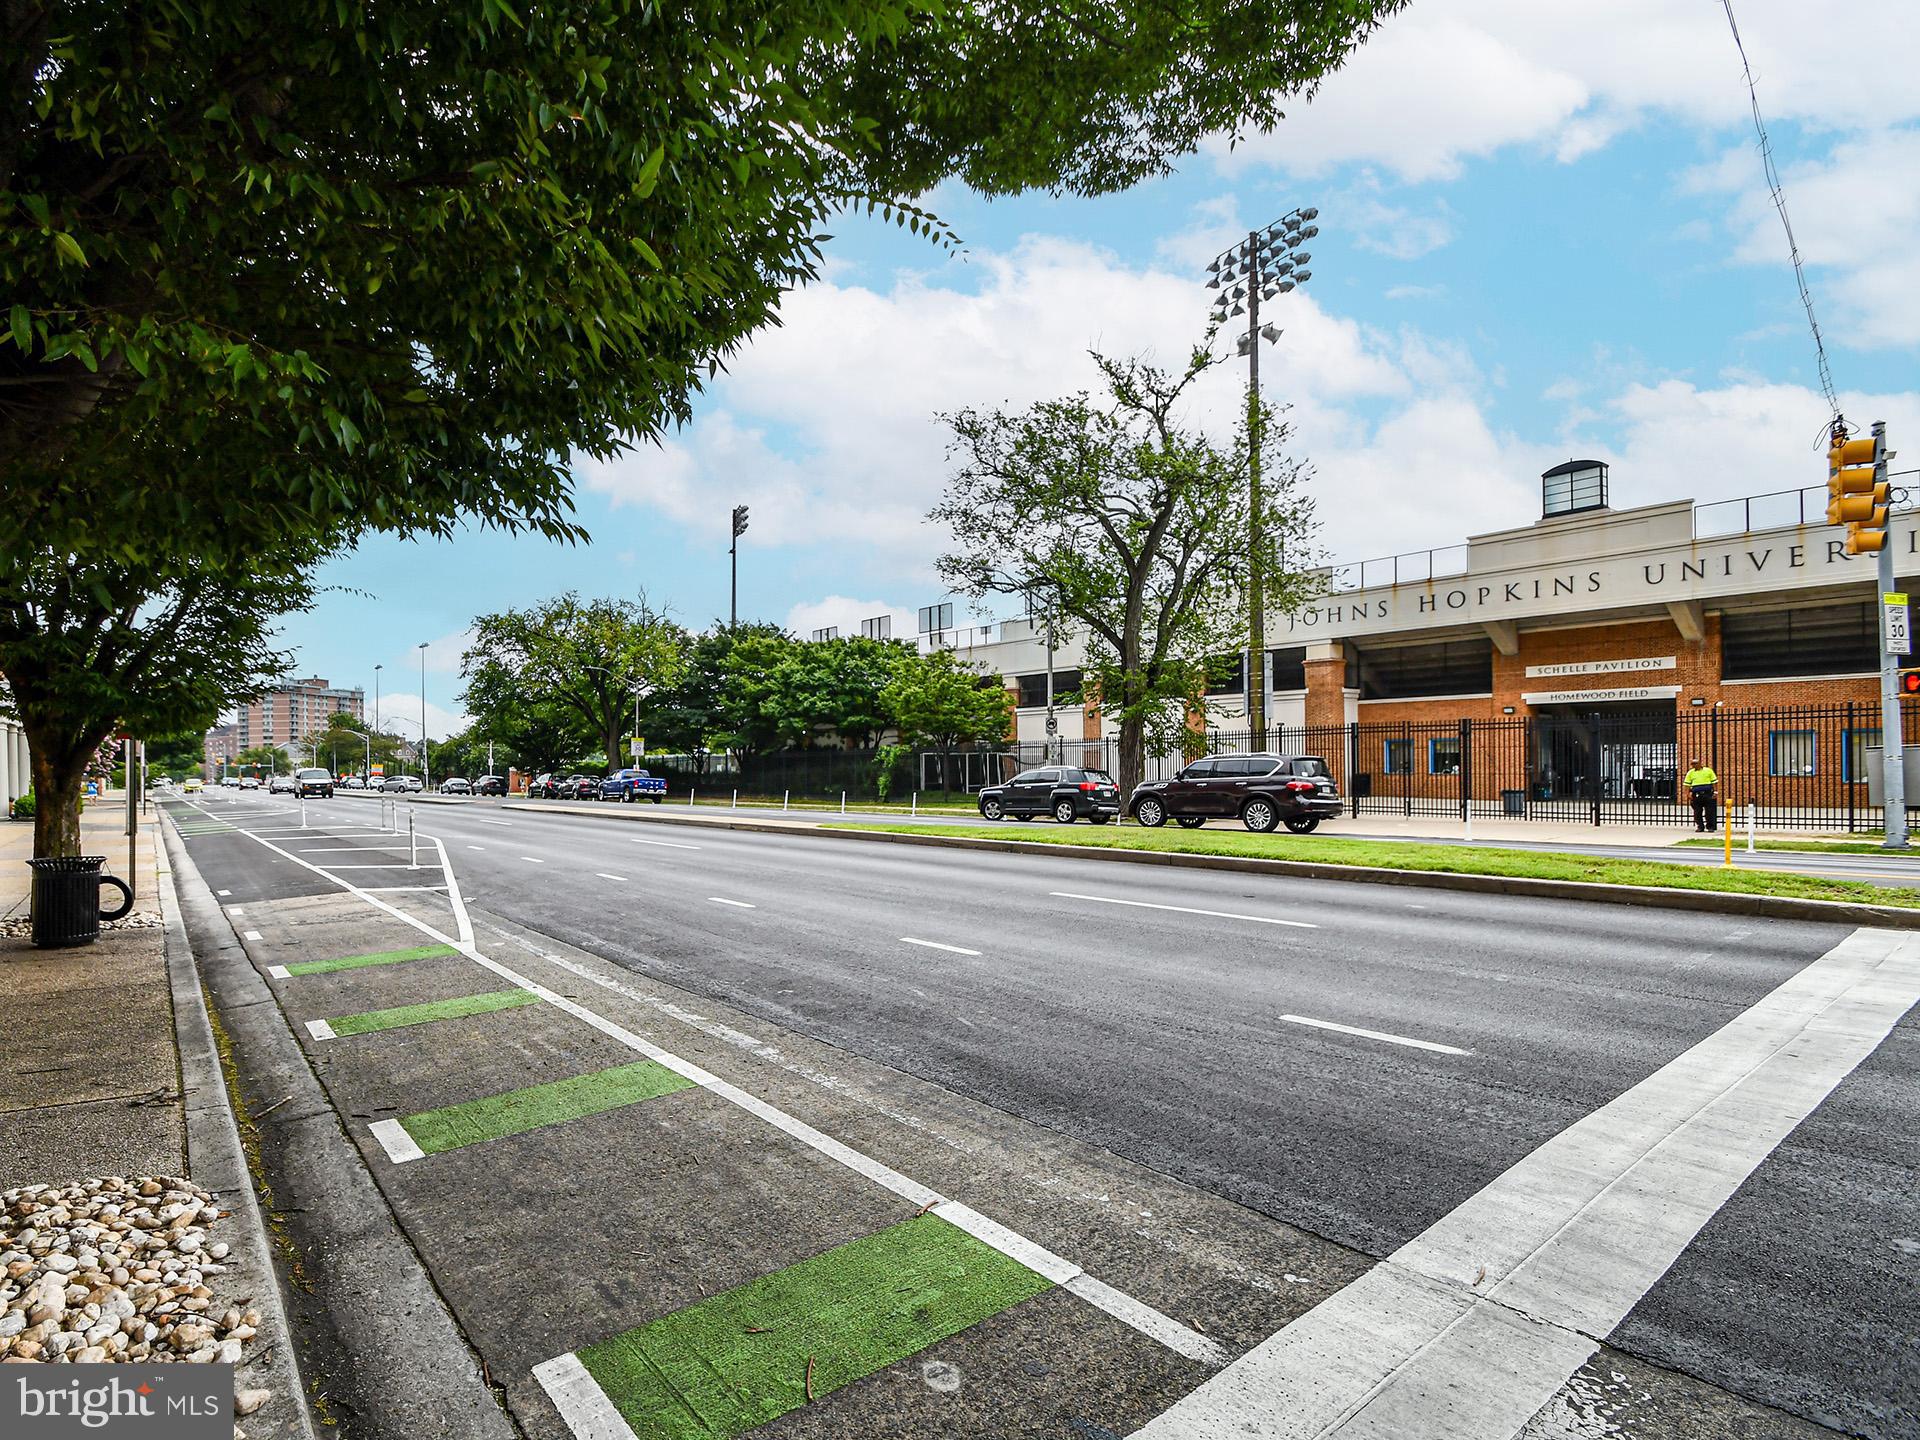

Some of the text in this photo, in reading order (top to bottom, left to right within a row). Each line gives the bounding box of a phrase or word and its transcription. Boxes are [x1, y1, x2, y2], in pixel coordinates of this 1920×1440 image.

[1289, 529, 1919, 632] JOHNS HOPKINS UNIVERI
[1891, 624, 1905, 638] 30
[1537, 659, 1663, 675] SCHELLE PAVILION
[1550, 689, 1649, 701] HOMEWOOD FIELD
